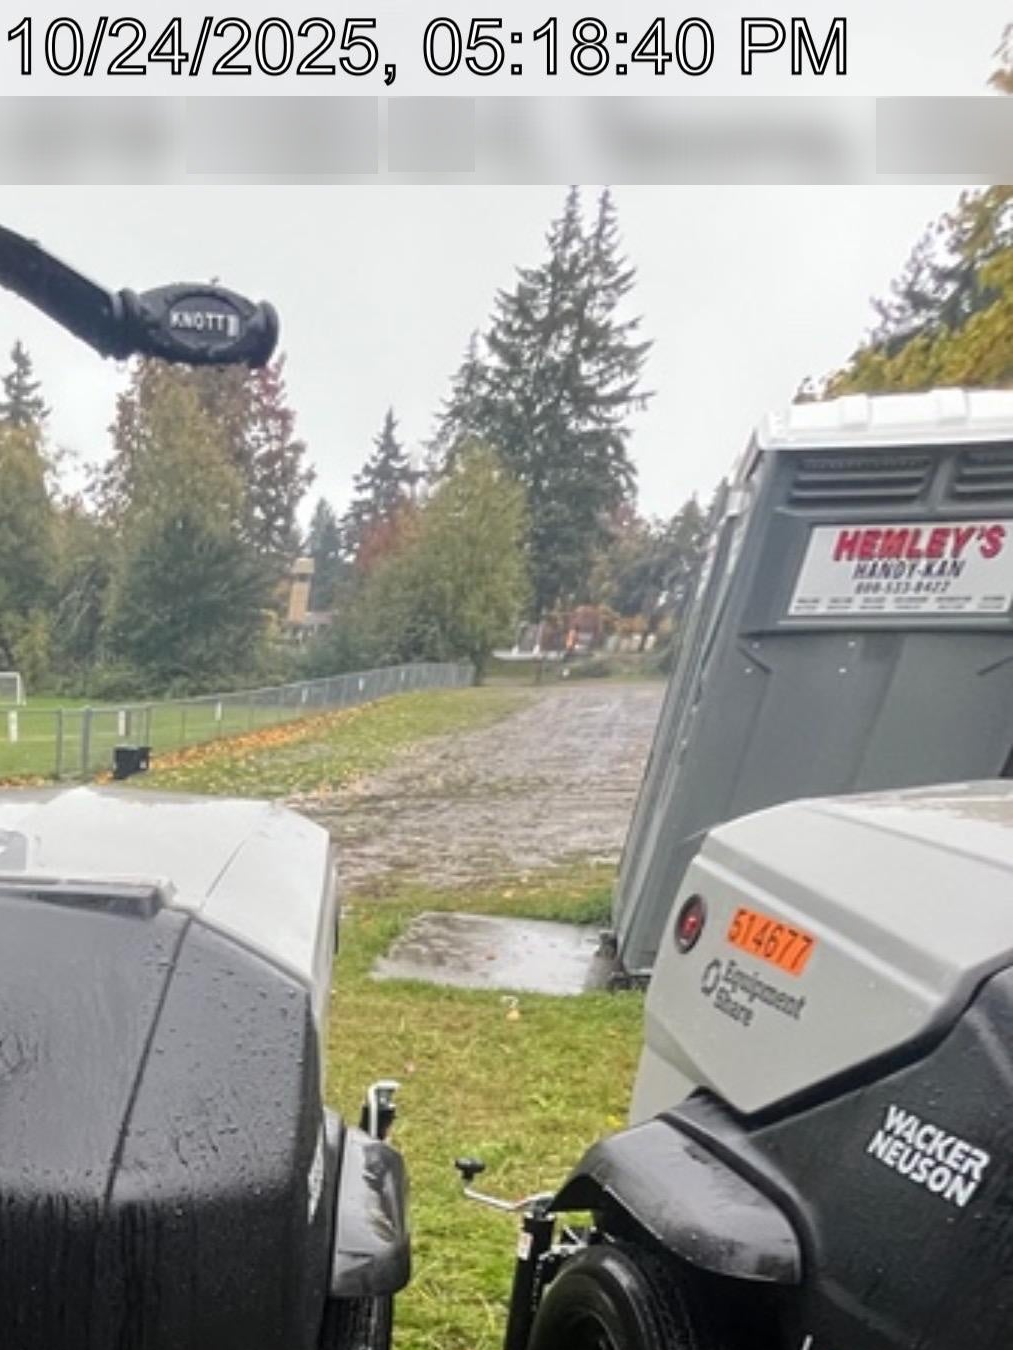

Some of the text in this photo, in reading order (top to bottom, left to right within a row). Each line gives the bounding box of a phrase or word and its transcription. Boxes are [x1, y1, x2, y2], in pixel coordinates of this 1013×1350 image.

[170, 310, 225, 331] KNOTT
[833, 524, 1006, 562] HEMLEY'S
[728, 908, 814, 970] 514677
[713, 986, 754, 1027] Share
[722, 959, 807, 1020] Equipment
[867, 1130, 977, 1207] NEUSON
[884, 1104, 990, 1181] WACKER
